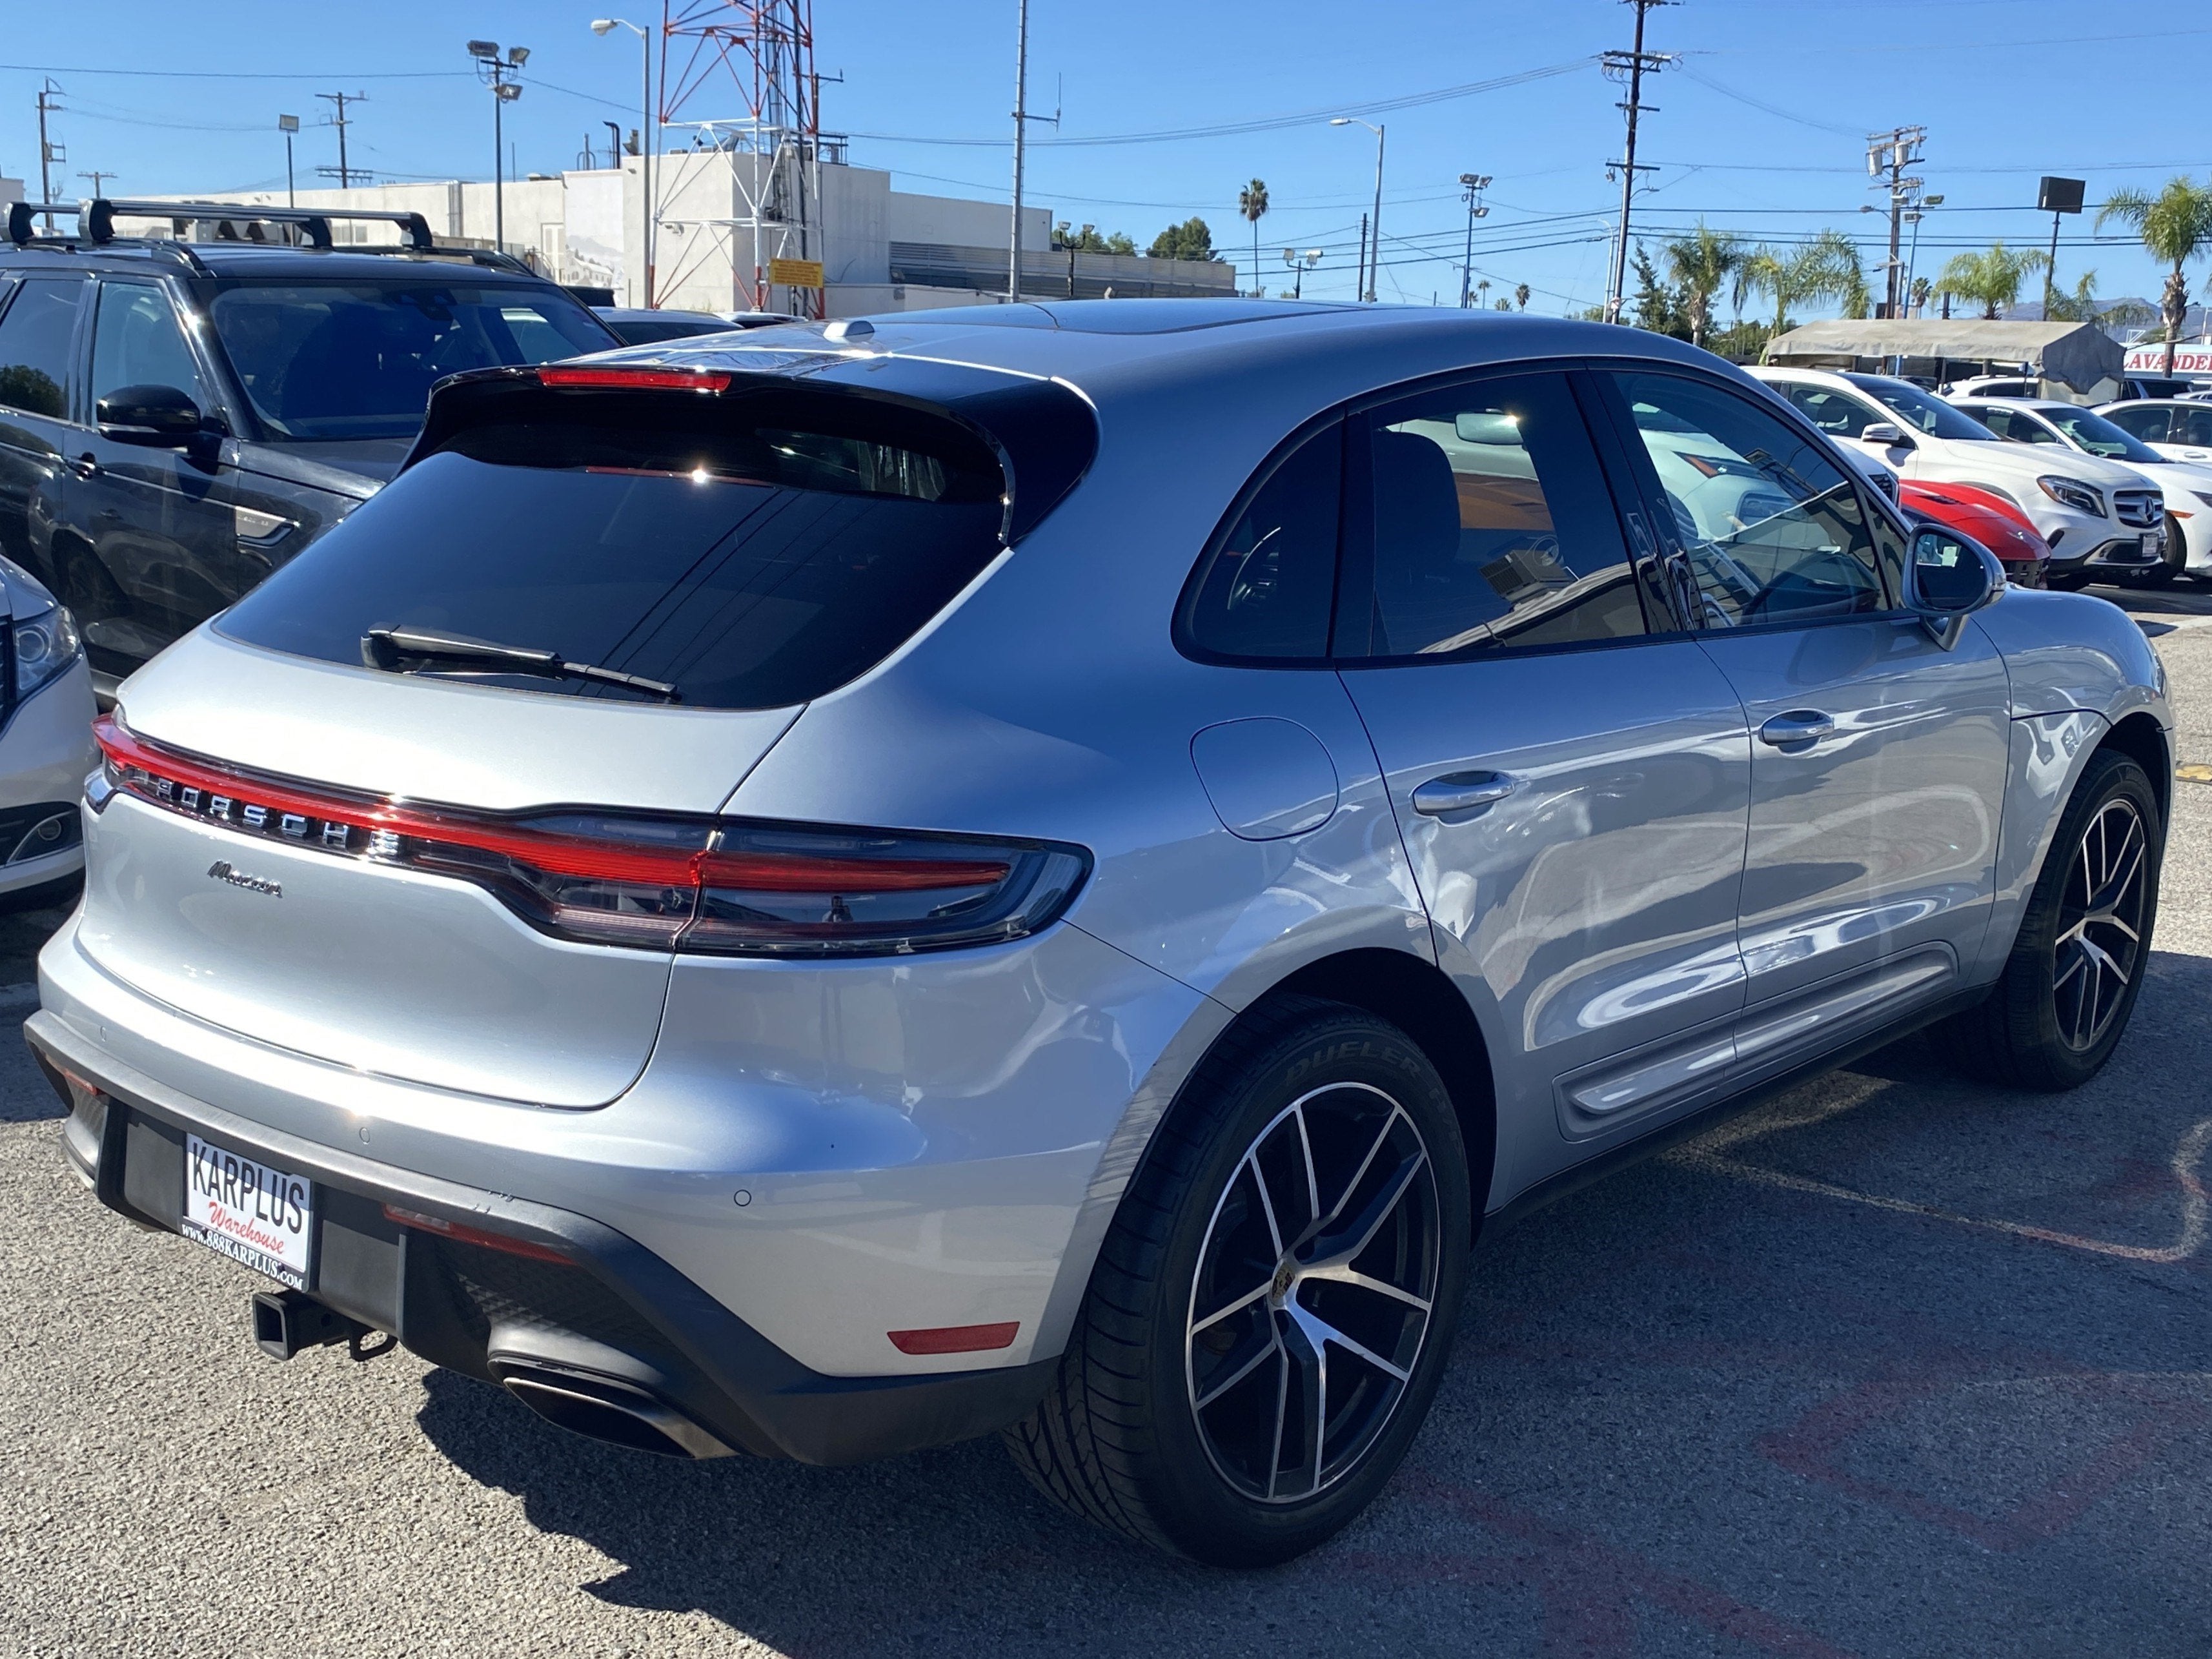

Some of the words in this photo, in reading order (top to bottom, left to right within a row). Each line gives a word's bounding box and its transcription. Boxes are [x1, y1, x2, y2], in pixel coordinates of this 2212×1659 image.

[2124, 353, 2212, 371] AVANDE
[156, 777, 399, 857] PORSCHE
[207, 859, 283, 899] Macan
[194, 1142, 305, 1234] KARPLUS
[208, 1201, 284, 1254] Warehouse
